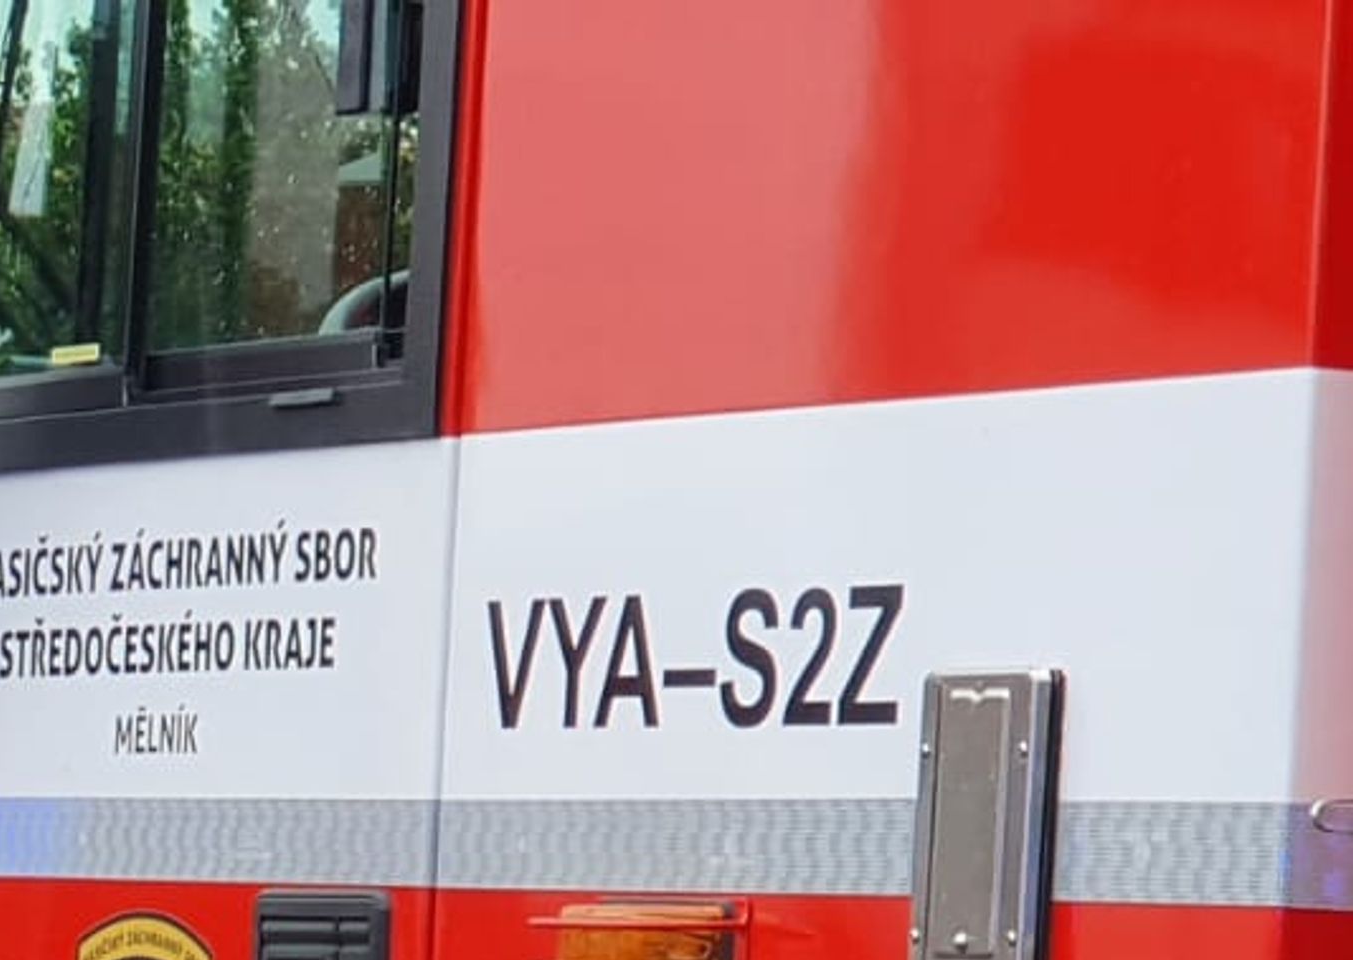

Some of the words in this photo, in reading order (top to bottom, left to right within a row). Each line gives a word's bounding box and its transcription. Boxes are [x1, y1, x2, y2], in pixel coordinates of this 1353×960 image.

[110, 520, 288, 592] ZÁCHRANNÝ
[295, 528, 376, 582] SBOR
[244, 617, 337, 670] KRAJE
[115, 705, 198, 755] MĚLNÍK
